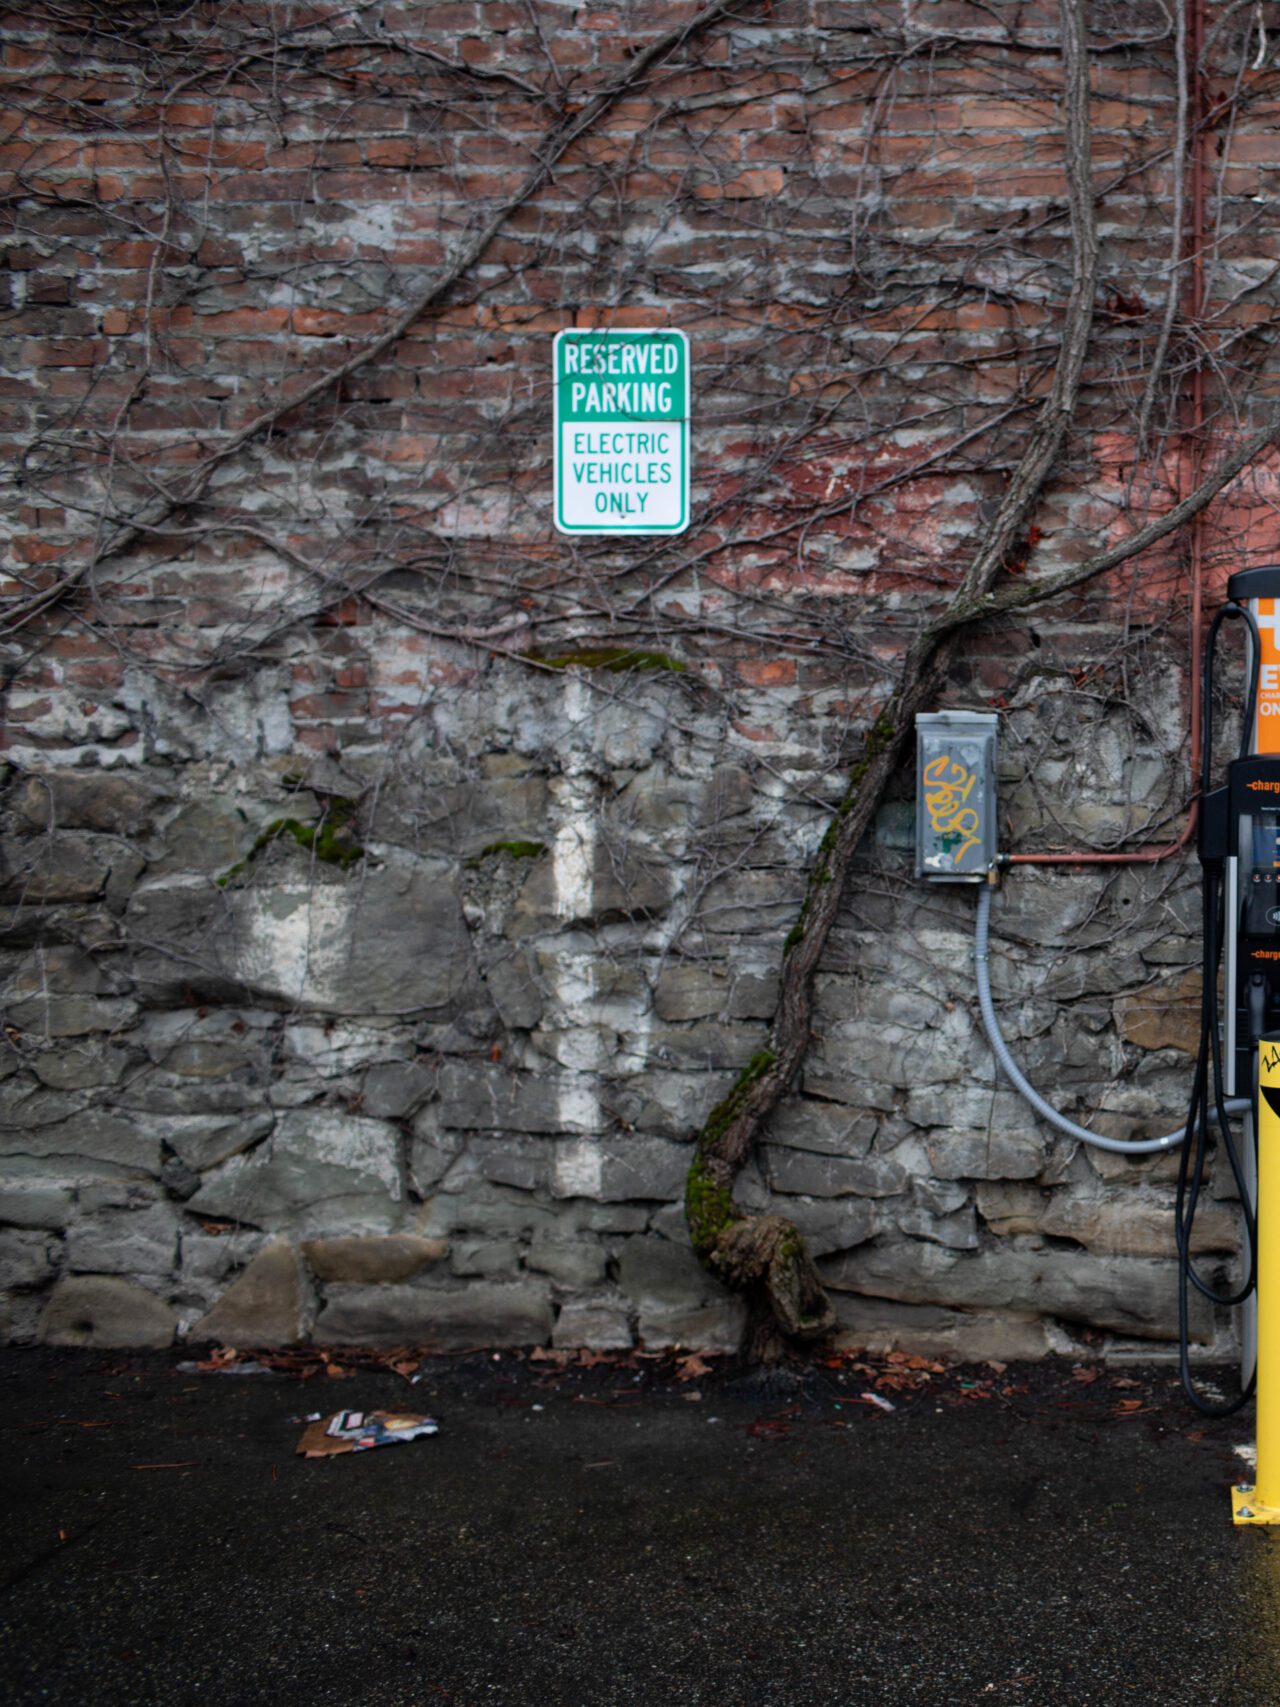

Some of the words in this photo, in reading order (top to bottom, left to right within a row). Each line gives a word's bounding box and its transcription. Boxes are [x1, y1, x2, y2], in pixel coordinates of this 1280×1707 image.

[565, 343, 679, 375] RESERVED
[571, 382, 672, 413] PARKING
[574, 433, 670, 454] ELECTRIC
[573, 462, 672, 484] VEHICLES
[595, 492, 649, 513] ONLY
